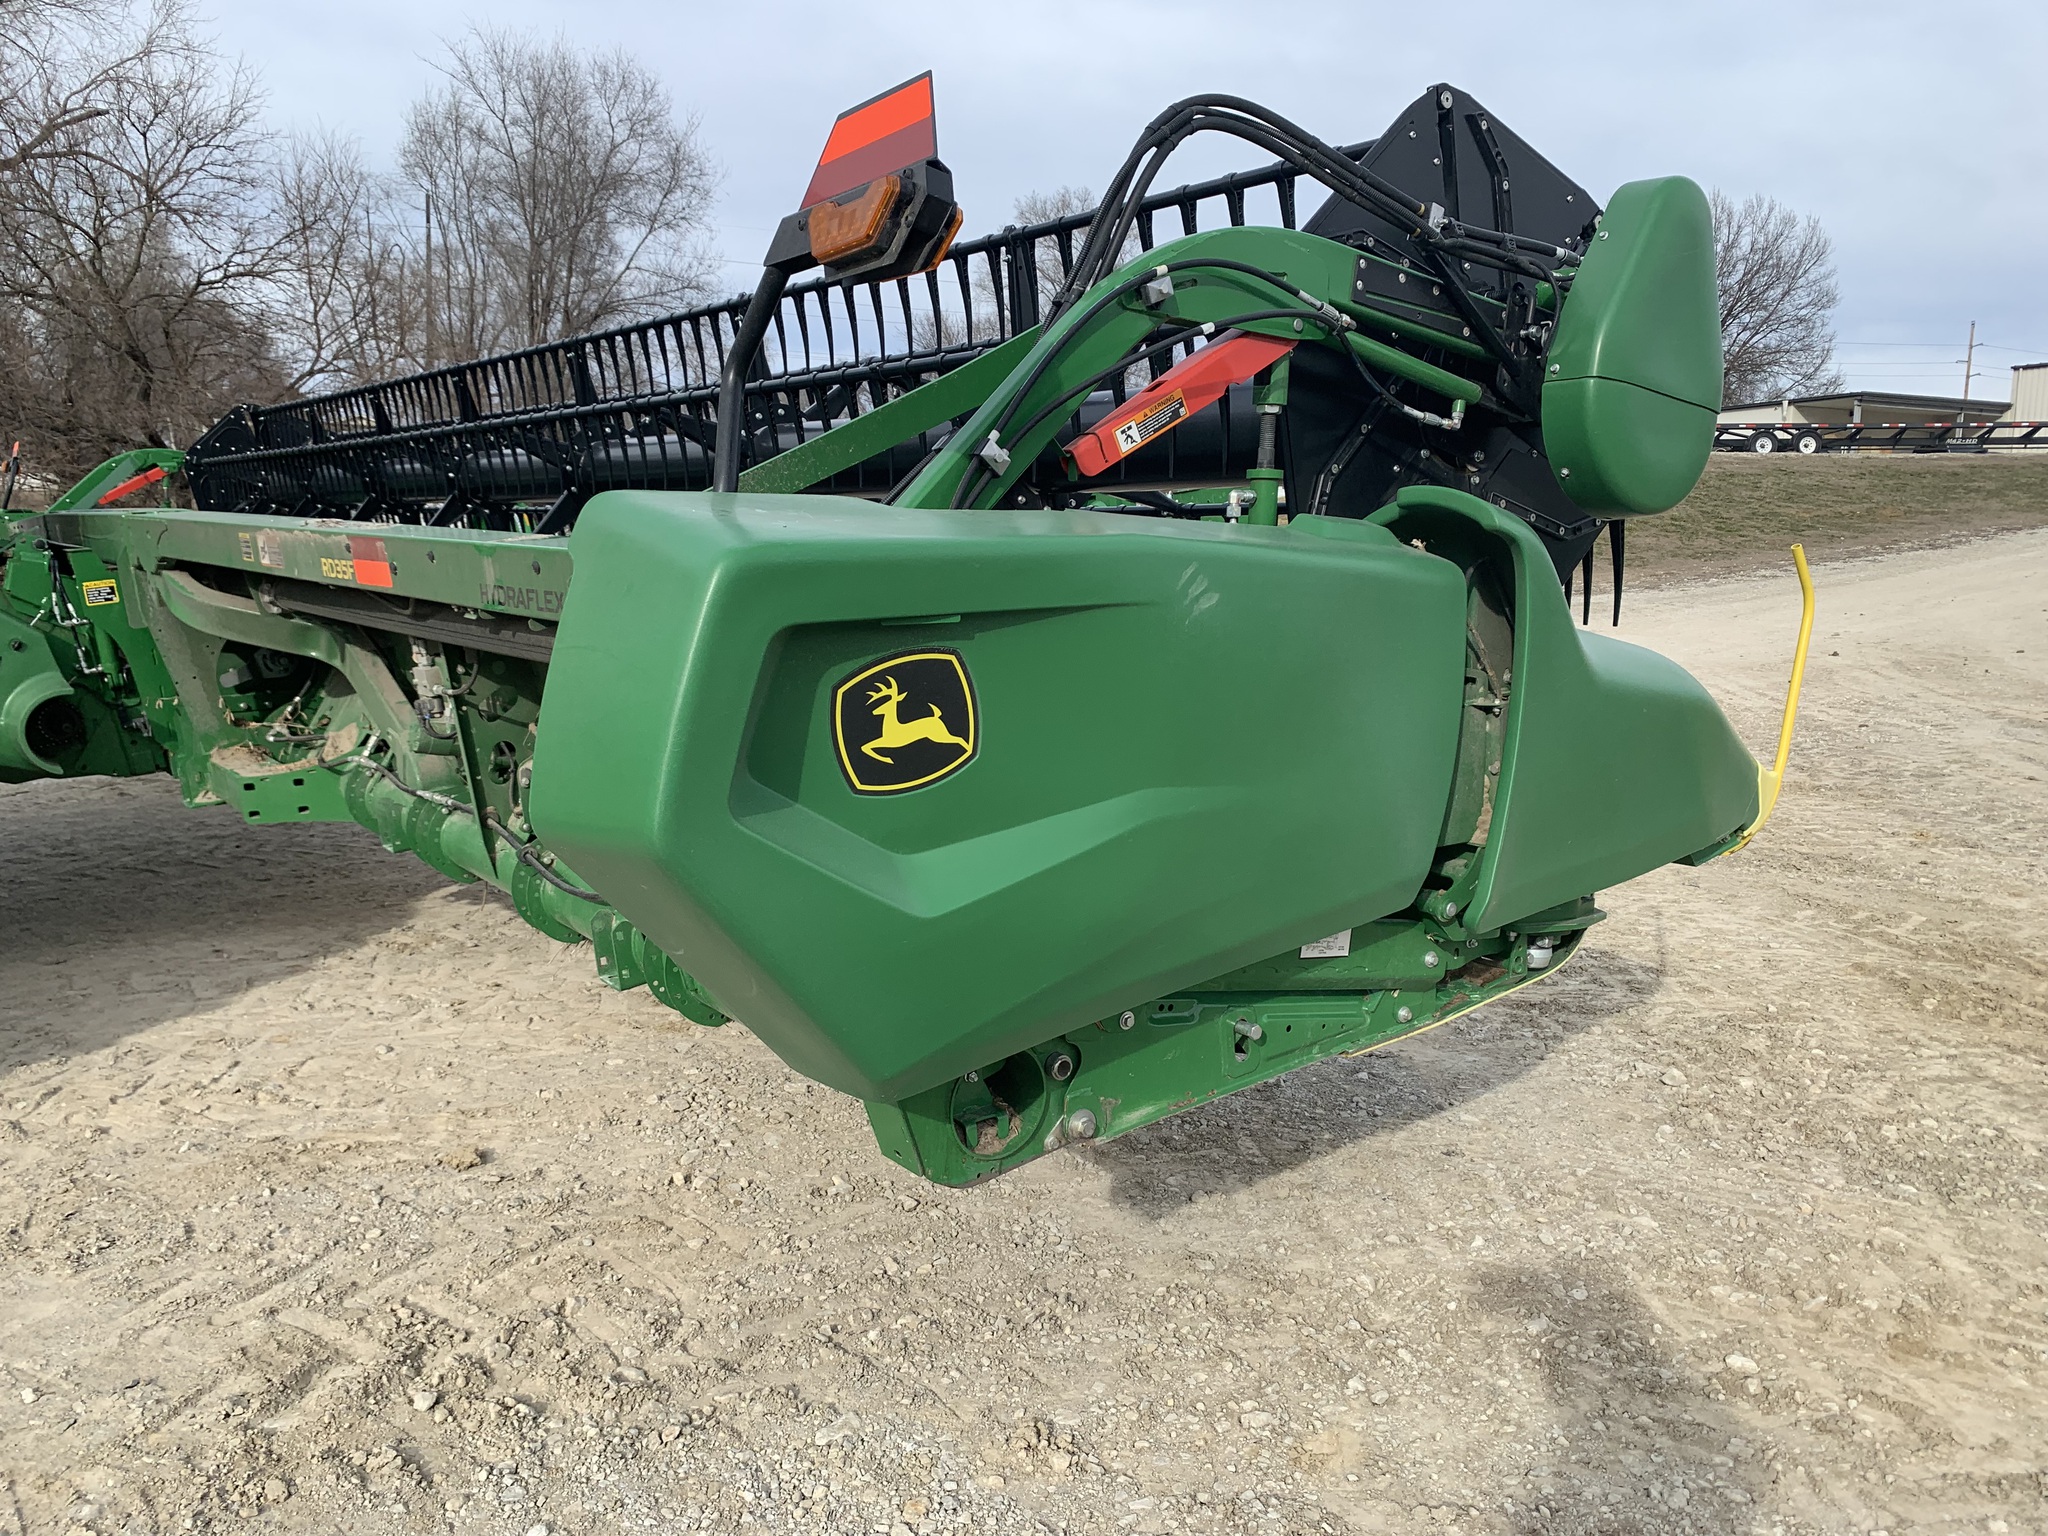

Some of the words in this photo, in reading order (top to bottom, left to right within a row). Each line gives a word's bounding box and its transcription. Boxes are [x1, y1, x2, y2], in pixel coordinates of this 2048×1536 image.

[1149, 394, 1175, 413] WARNING
[320, 557, 354, 580] RD35F
[479, 582, 564, 614] HYDRAFLEX
